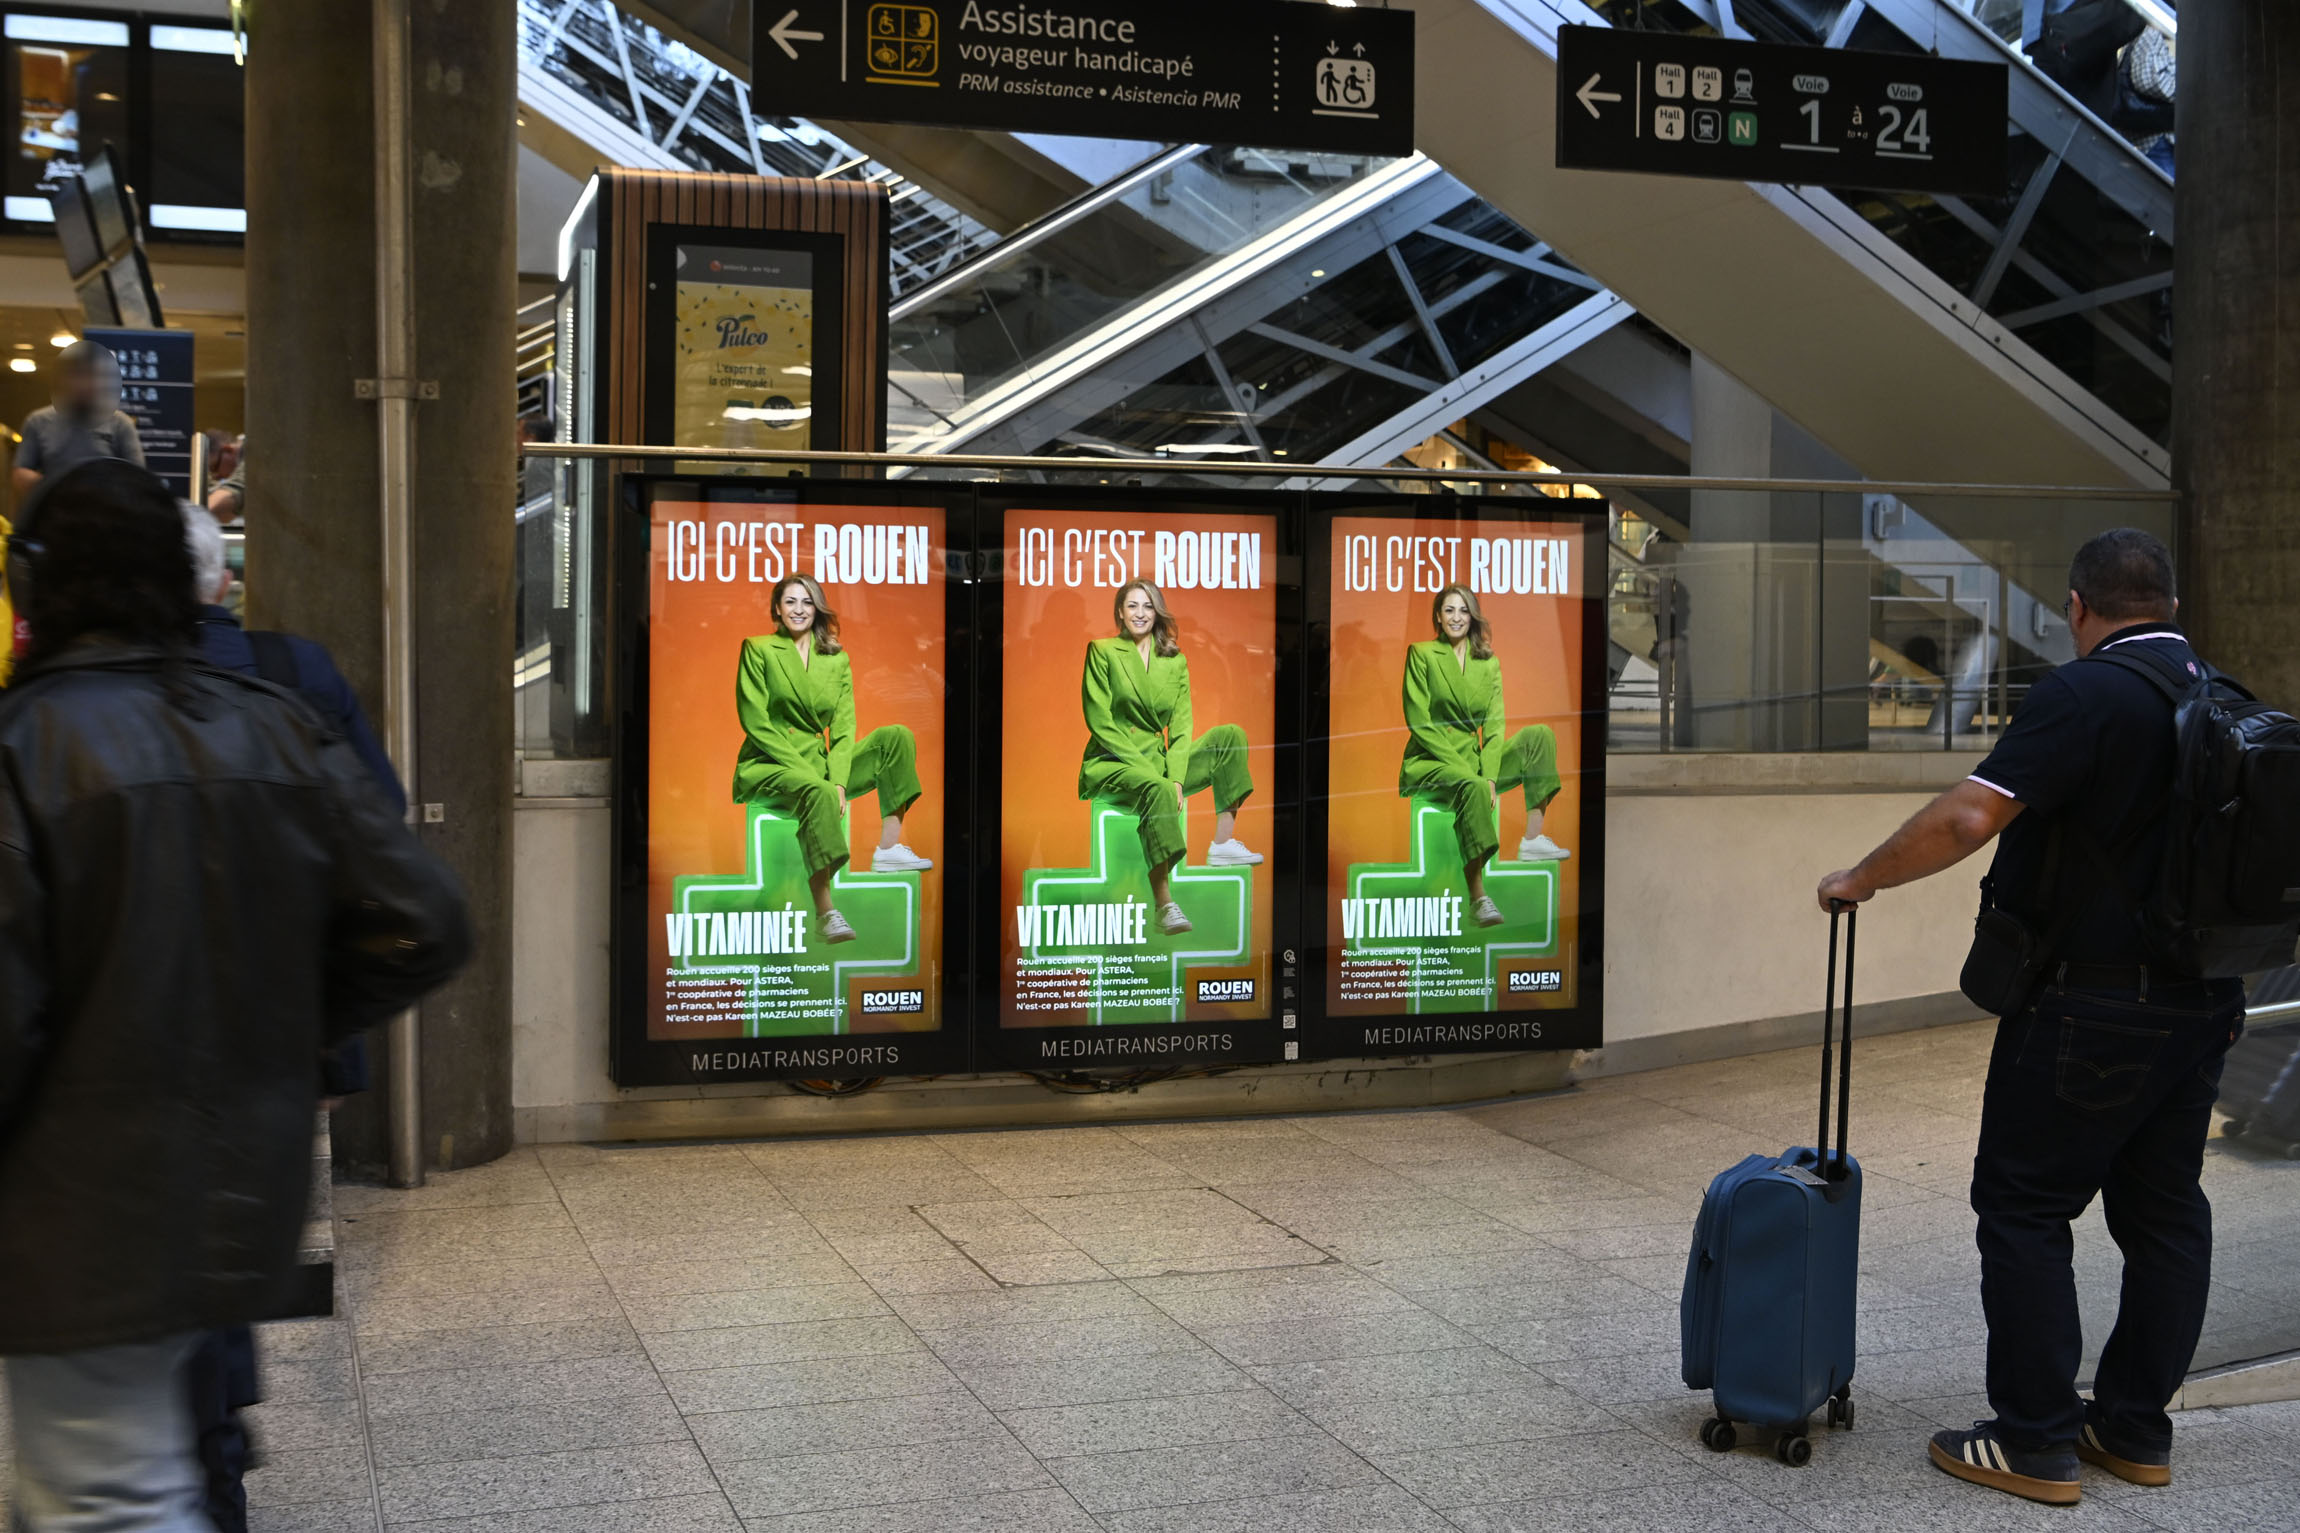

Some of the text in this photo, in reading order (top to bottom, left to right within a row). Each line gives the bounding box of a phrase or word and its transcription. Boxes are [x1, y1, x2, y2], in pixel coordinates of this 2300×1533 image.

[959, 0, 1136, 44] Assistance
[959, 43, 1194, 80] voyageur handicapé
[1660, 66, 1680, 78] Hall
[1697, 70, 1718, 80] Hall
[959, 73, 1241, 110] PRM assistance Asistencia PMR
[1667, 80, 1674, 94] 1
[1702, 82, 1711, 97] 2
[1796, 77, 1825, 92] Voie
[1891, 85, 1919, 99] Voie
[1660, 109, 1680, 120] Hall
[1665, 122, 1674, 137] 4
[1735, 119, 1750, 139] N
[1800, 99, 1930, 152] 1 à 24
[716, 317, 768, 349] Pulco
[668, 520, 928, 585] ICI C'EST ROUEN
[1019, 528, 1260, 589] ICI C'EST ROUEN
[1345, 535, 1568, 594] ICI C'EST ROUEN
[1341, 888, 1462, 939] VITAMINÉE
[1017, 895, 1147, 947] VITAMINÉE
[666, 902, 807, 956] VITAMINÉE
[1424, 947, 1449, 955] sièges
[1451, 946, 1481, 955] français
[1017, 958, 1045, 966] Rouen
[1105, 955, 1132, 964] sièges
[1135, 954, 1167, 964] français
[762, 965, 791, 975] sièges
[794, 964, 829, 974] français
[1028, 968, 1074, 976] mondiaux.
[1098, 967, 1134, 975] ASTERA,
[1351, 970, 1397, 978] coopérative
[1412, 969, 1463, 977] pharmaciens
[679, 979, 728, 987] mondiaux.
[755, 977, 793, 985] ASTERA,
[1027, 980, 1078, 988] coopérative
[1093, 977, 1148, 987] pharmaciens
[1397, 979, 1434, 987] décisions
[1510, 971, 1560, 985] ROUEN
[678, 991, 732, 999] coopérative
[749, 988, 808, 998] pharmaciens
[1030, 991, 1061, 999] France,
[1078, 989, 1117, 997] décisions
[1131, 988, 1170, 997] prennent
[1199, 981, 1253, 995] ROUEN
[1458, 987, 1485, 996] BOBÉE
[681, 1002, 714, 1010] France,
[717, 1001, 730, 1009] les
[732, 1000, 775, 1008] décisions
[790, 1000, 832, 1008] prennent
[863, 991, 922, 1006] ROUEN
[1016, 1002, 1051, 1010] N'est-ce
[1053, 1003, 1069, 1011] pas
[1104, 999, 1141, 1007] MAZEAU
[1143, 997, 1172, 1006] BOBÉE
[666, 1014, 704, 1022] N'est-ce
[706, 1015, 722, 1023] pas
[760, 1011, 800, 1019] MAZEAU
[803, 1008, 835, 1018] BOBÉE
[1365, 1022, 1542, 1044] MEDIATRANSPORTS
[1041, 1034, 1232, 1057] MEDIATRANSPORTS
[692, 1047, 899, 1071] MEDIATRANSPORTS
